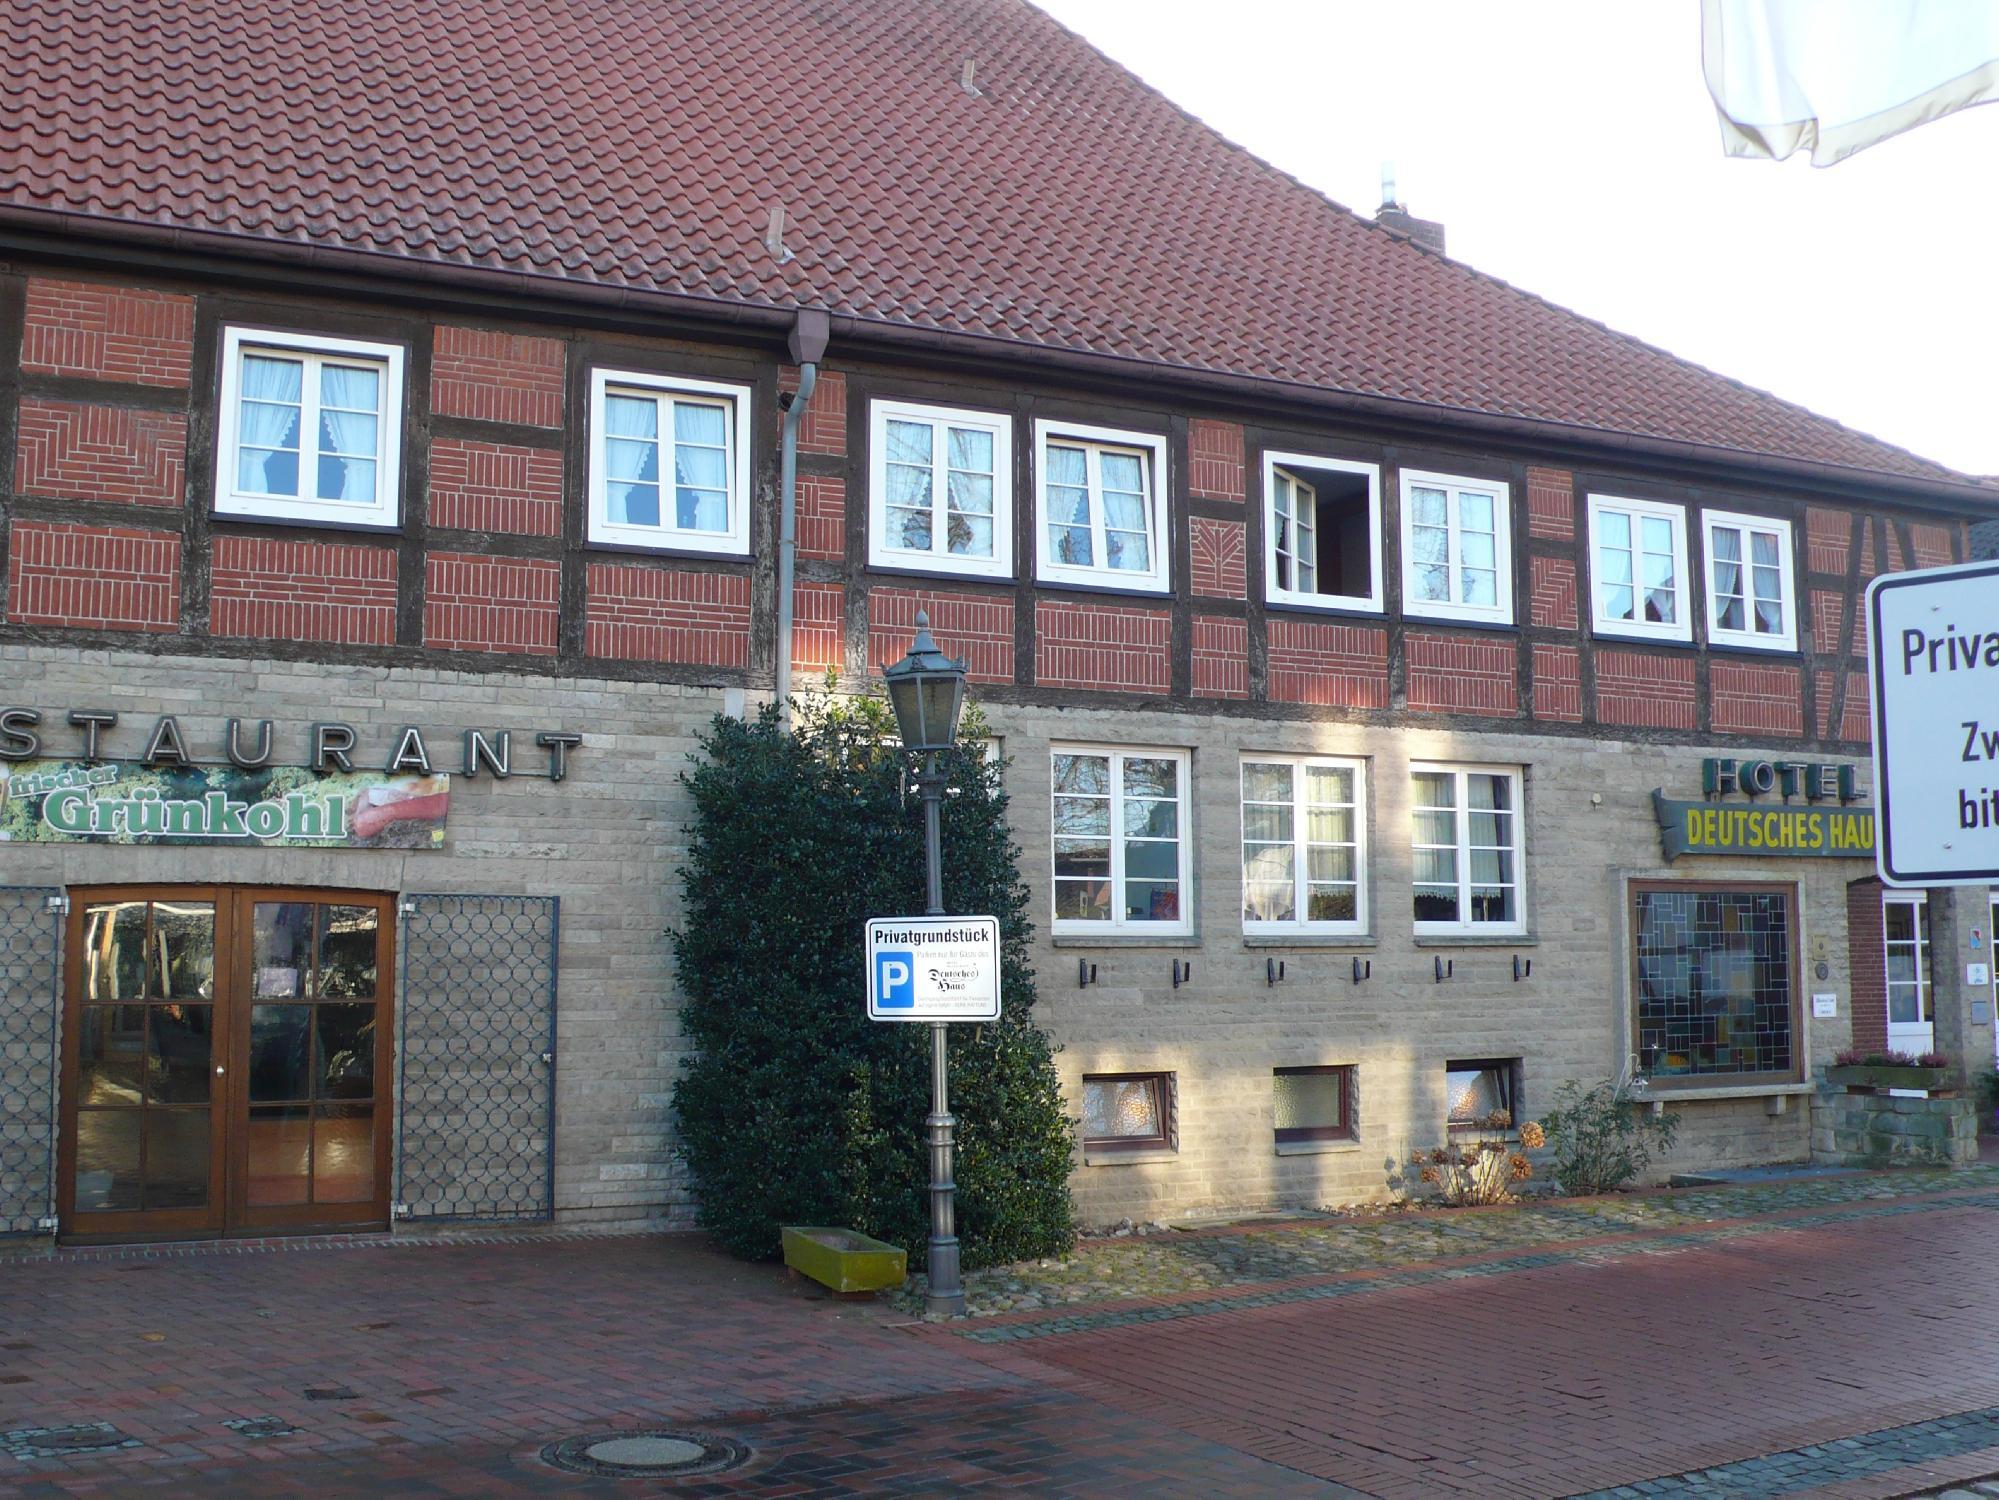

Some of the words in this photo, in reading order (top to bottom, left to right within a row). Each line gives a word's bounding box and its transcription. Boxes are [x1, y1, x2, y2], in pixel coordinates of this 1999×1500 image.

[8, 764, 118, 798] frischer
[1702, 758, 1868, 800] HOTEL
[43, 788, 347, 839] Grünkohl
[1687, 808, 1824, 849] DEUTSCHES
[875, 927, 989, 946] Privatgrundstück
[882, 960, 909, 999] P
[928, 968, 979, 983] Deutsches
[937, 979, 966, 992] Haus
